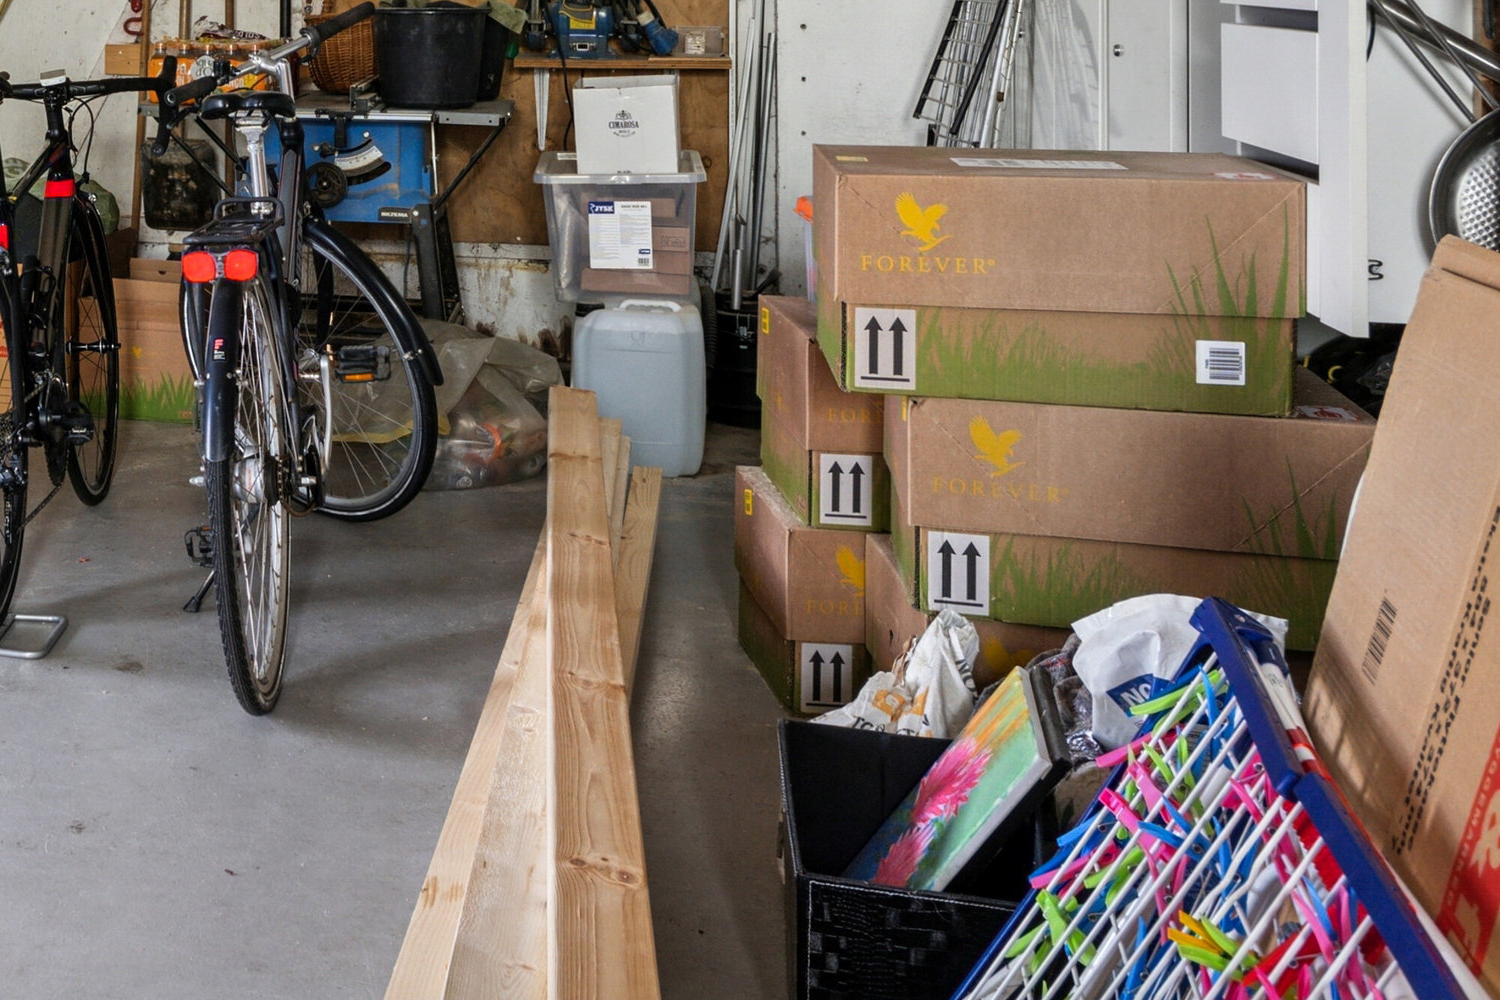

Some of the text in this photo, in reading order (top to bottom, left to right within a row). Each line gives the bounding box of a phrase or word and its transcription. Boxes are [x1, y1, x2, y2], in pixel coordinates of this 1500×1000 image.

[608, 120, 639, 129] CIMAROSA
[595, 204, 614, 212] JYSK
[1461, 596, 1491, 688] Senior
